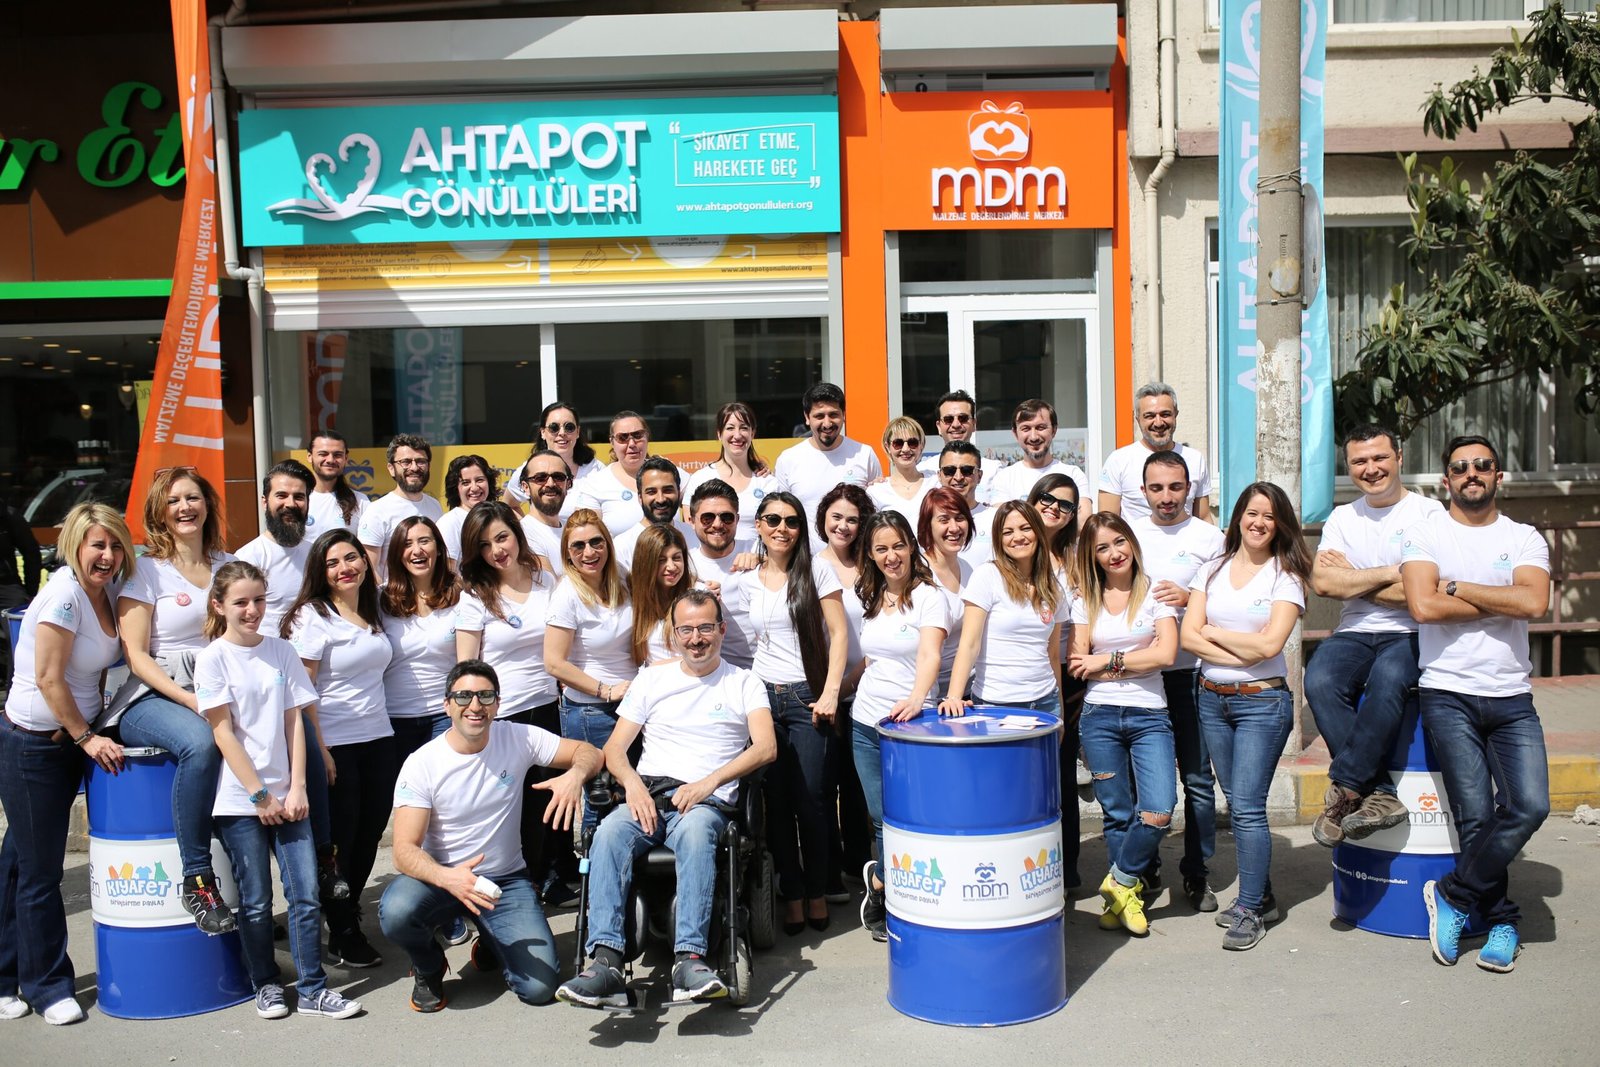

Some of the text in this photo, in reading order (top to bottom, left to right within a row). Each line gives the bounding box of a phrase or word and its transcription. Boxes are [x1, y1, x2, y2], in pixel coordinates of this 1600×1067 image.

[400, 121, 647, 173] AHTAPOT
[759, 132, 800, 152] ETME,
[693, 158, 798, 178] HAREKETE GEÇ
[402, 175, 637, 217] GÖNÜLLÜLERİ
[676, 200, 813, 213] www.ahtapotgonulluleri.org
[932, 212, 967, 221] MALZEME
